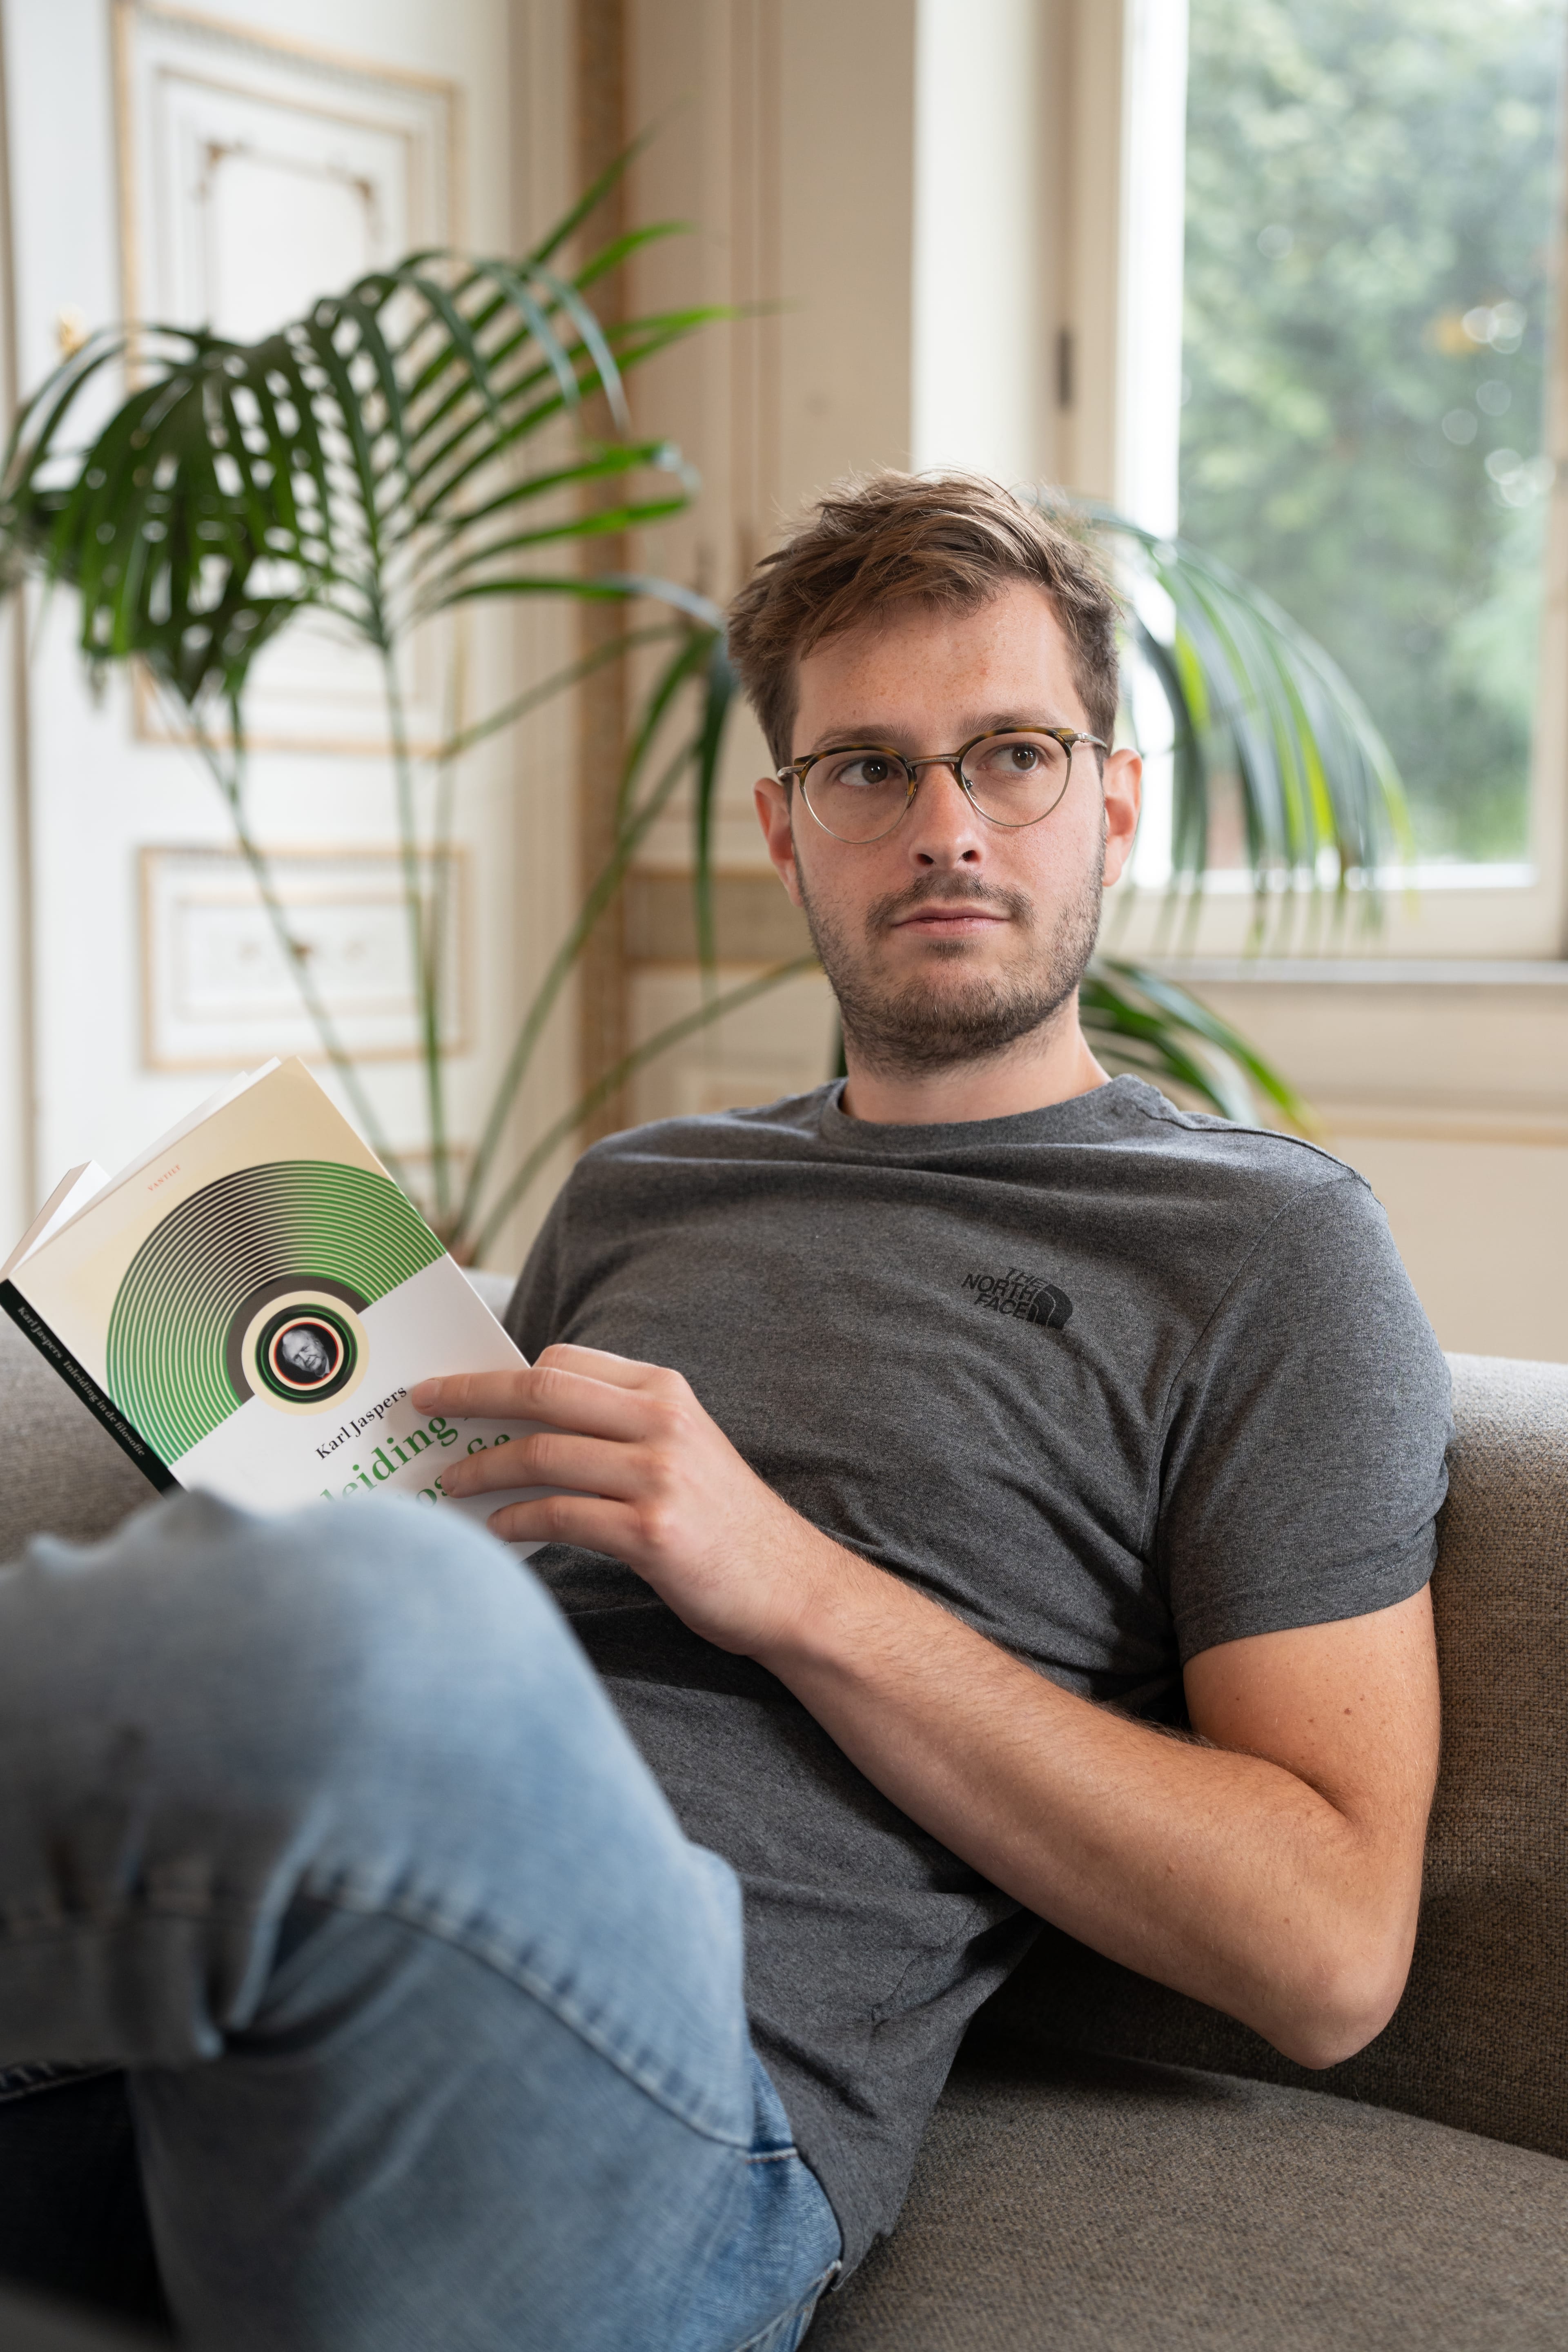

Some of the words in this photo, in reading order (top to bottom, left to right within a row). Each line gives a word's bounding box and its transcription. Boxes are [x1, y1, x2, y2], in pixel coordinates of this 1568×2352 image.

[961, 1274, 1039, 1301] NORTH
[1005, 1267, 1049, 1289] THE
[973, 1293, 1031, 1320] FACE
[18, 1306, 38, 1327] Karl
[31, 1326, 62, 1359] Jaspers
[63, 1361, 99, 1403] Inleiding
[97, 1400, 107, 1412] in
[105, 1411, 117, 1423] de
[114, 1422, 145, 1456] filosofie
[314, 1426, 352, 1460] Karl
[348, 1387, 407, 1438] Jaspers
